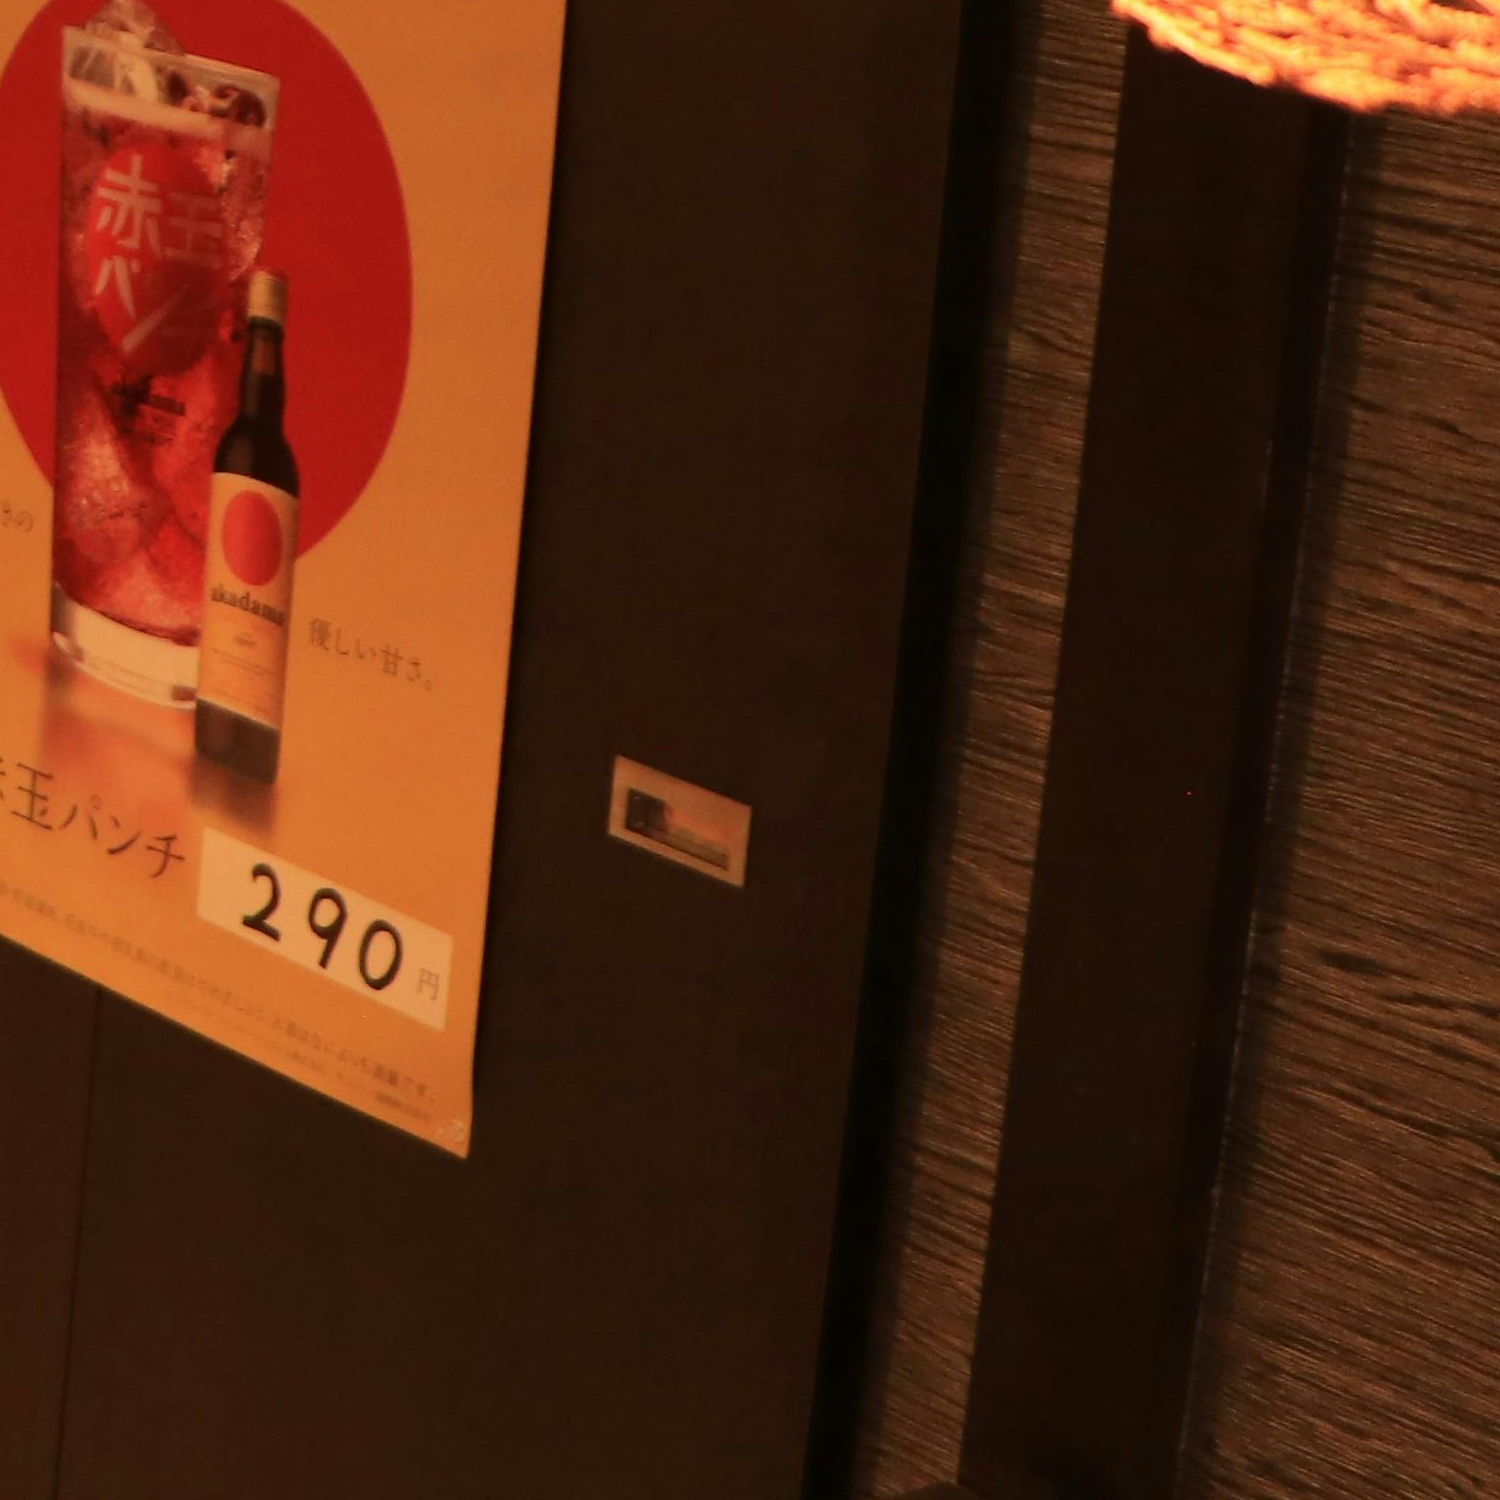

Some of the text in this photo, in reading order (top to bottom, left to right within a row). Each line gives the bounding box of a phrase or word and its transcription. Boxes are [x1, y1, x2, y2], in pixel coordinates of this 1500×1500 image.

[310, 617, 433, 691] 優しい甘さ。
[242, 862, 440, 1002] 290 円
